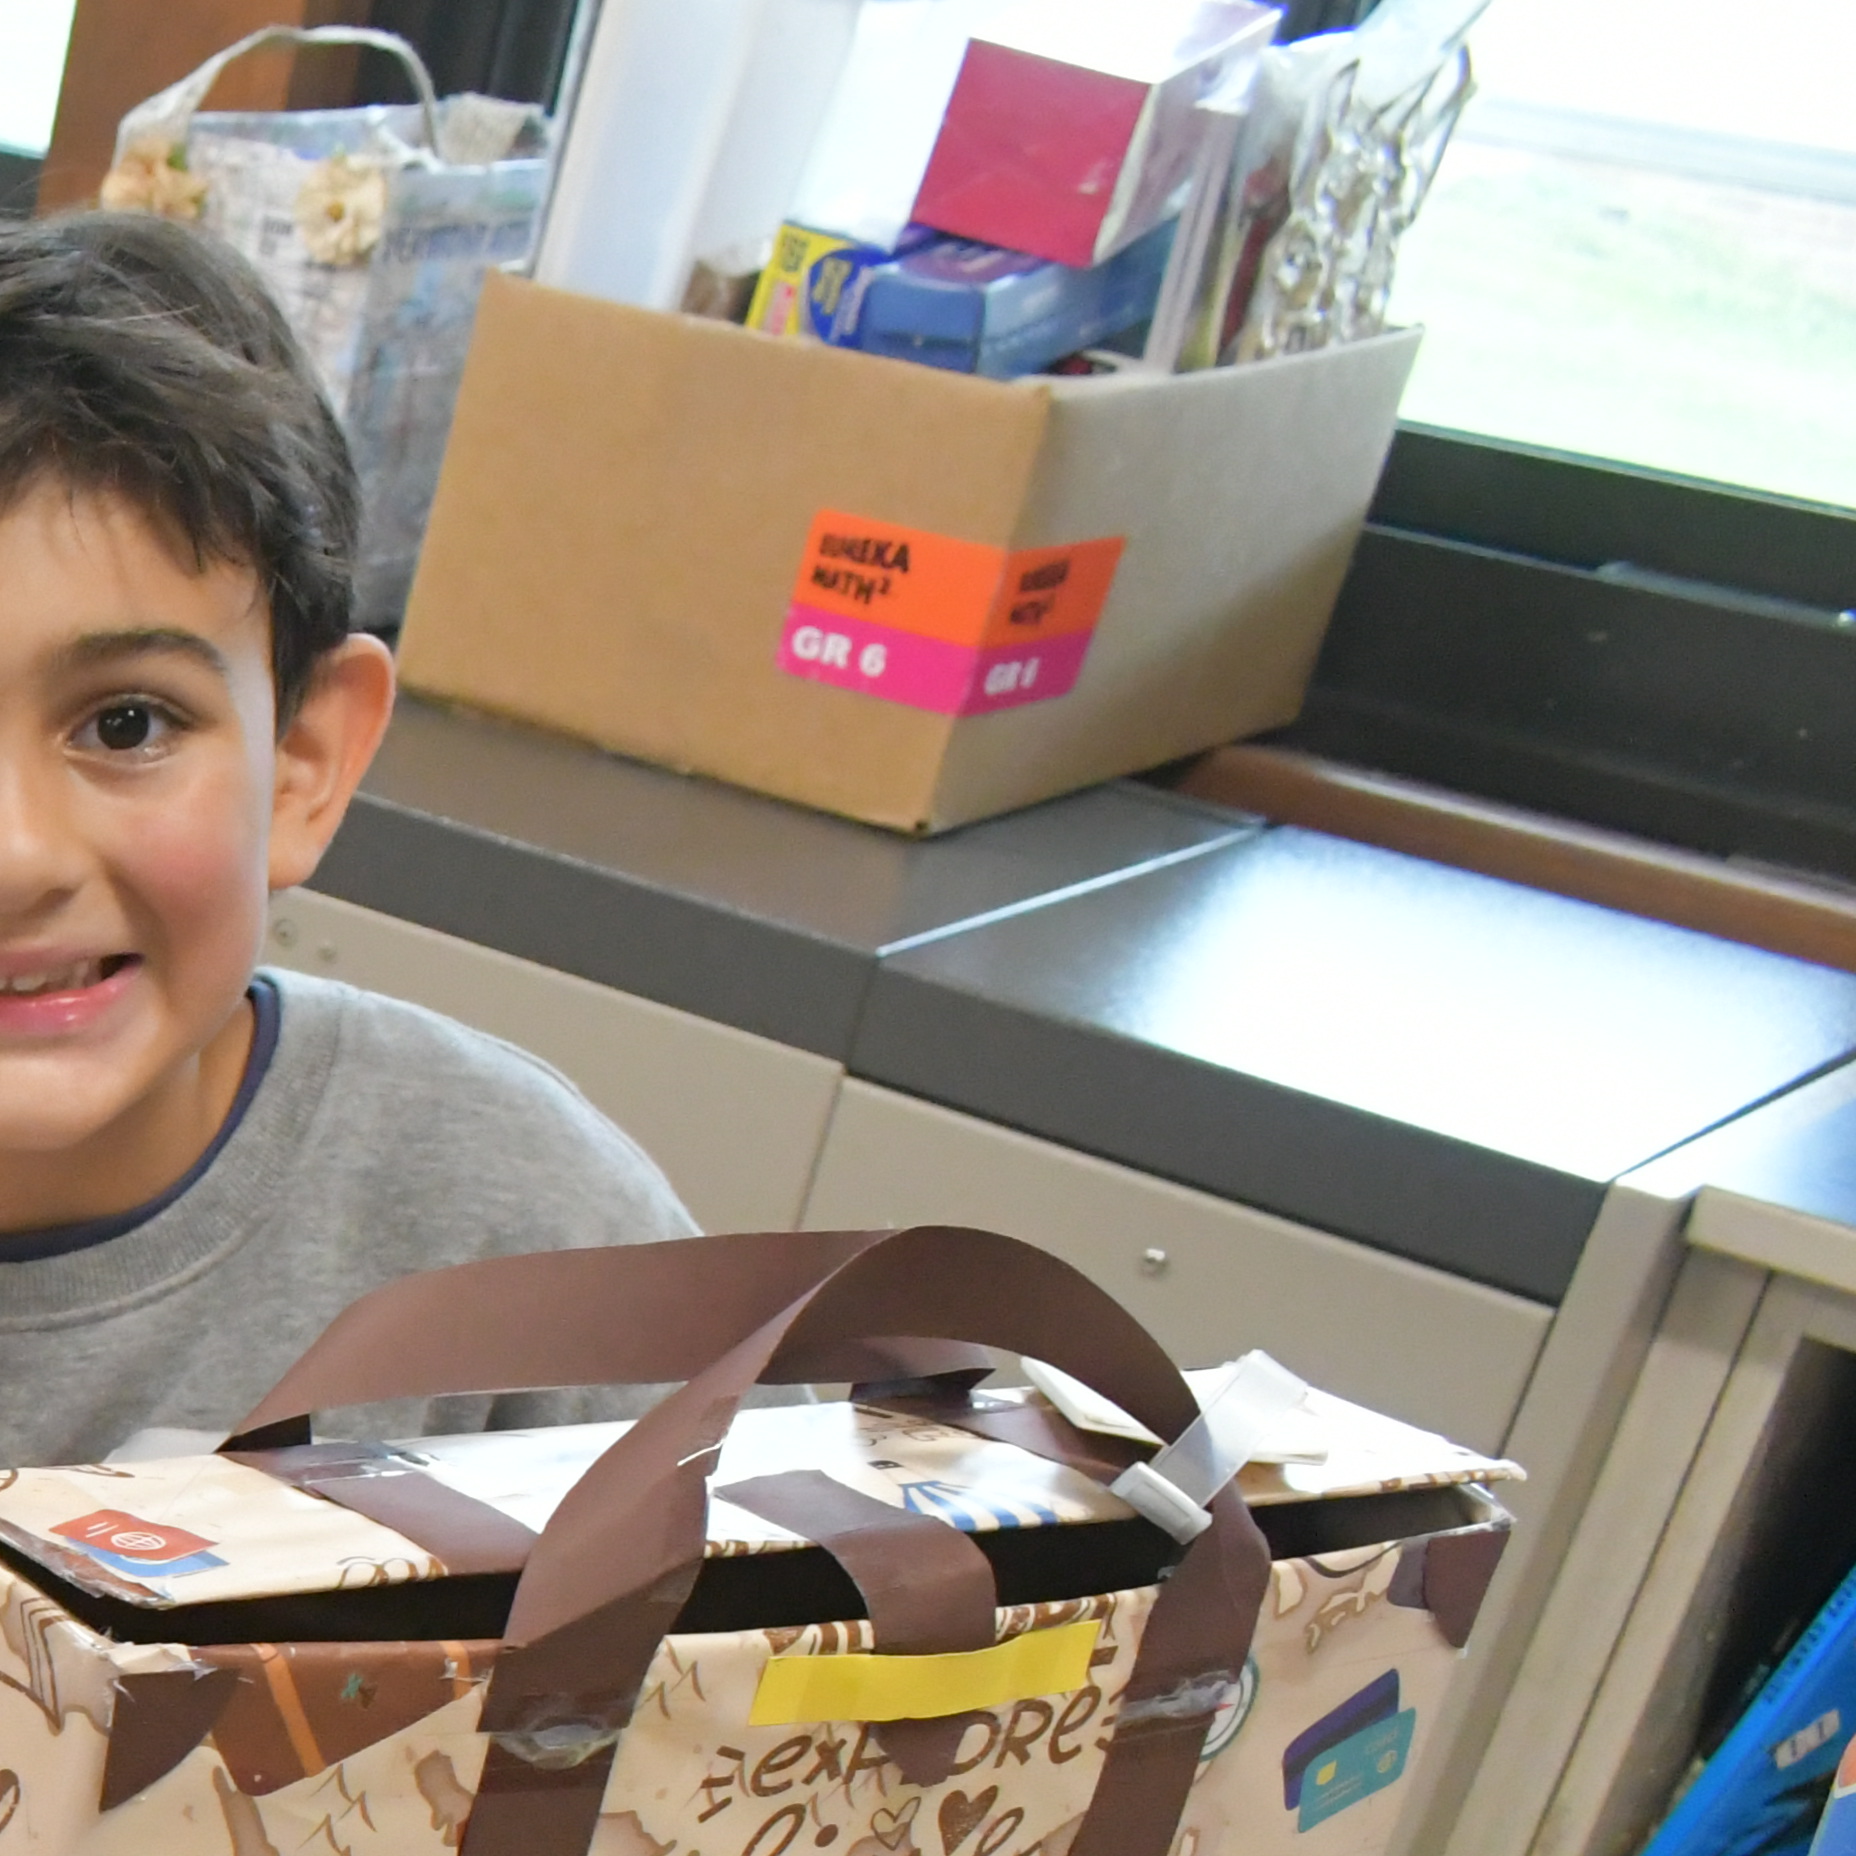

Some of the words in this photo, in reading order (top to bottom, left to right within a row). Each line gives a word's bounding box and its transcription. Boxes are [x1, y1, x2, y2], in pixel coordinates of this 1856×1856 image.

[818, 532, 912, 575] EUREKA
[791, 624, 850, 669] GR
[857, 643, 889, 679] 6
